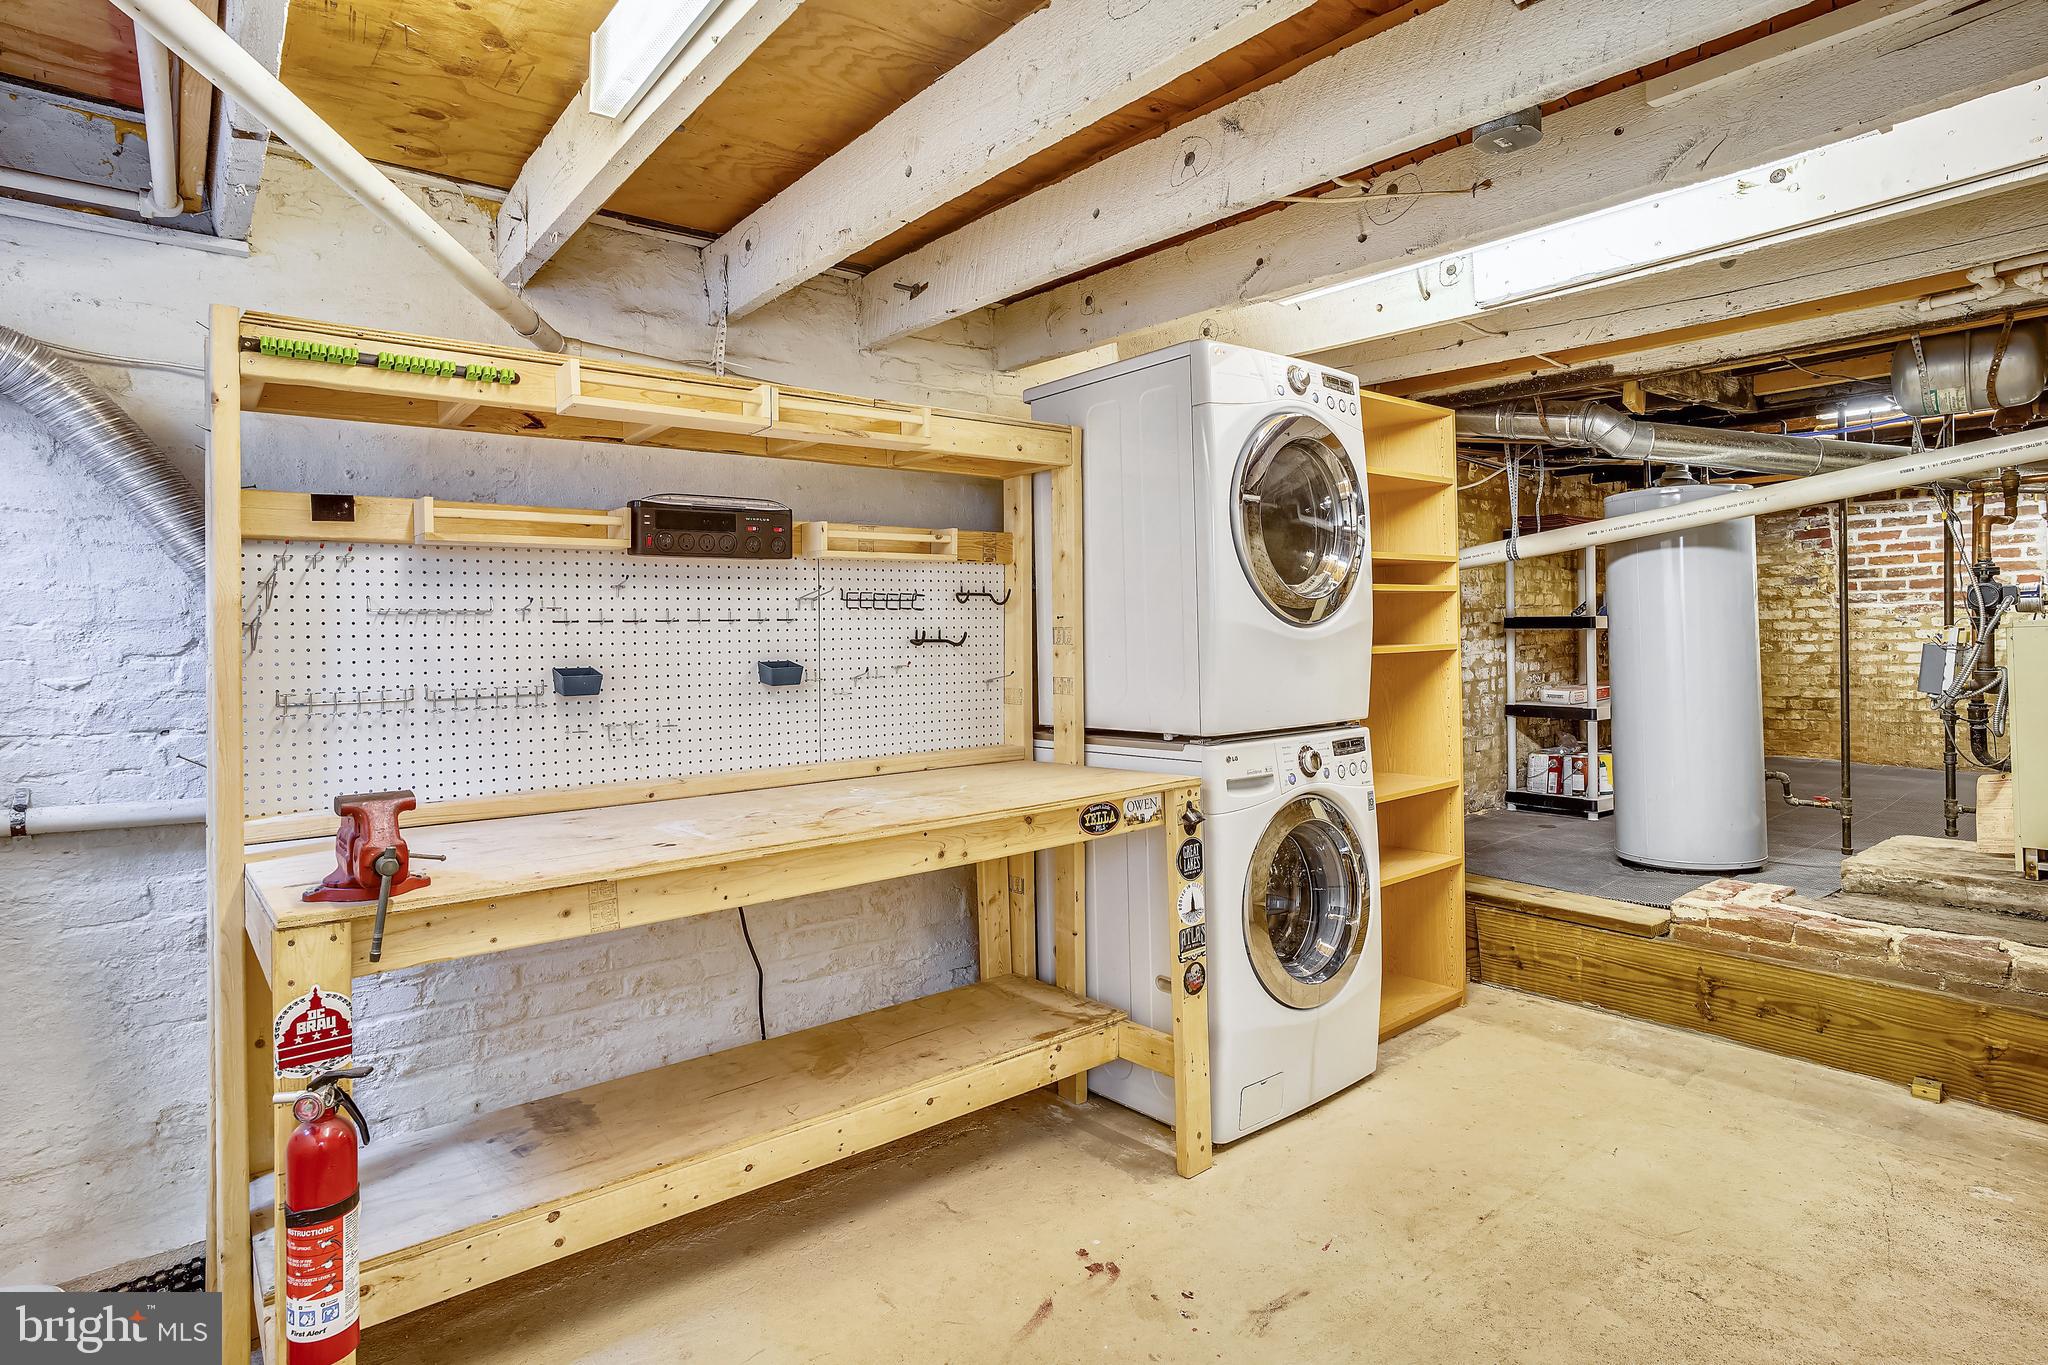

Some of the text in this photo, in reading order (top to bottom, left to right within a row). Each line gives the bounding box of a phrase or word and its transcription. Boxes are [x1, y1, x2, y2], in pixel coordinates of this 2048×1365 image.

[1126, 797, 1158, 812] OWEN
[1083, 810, 1117, 826] YELLA
[1182, 843, 1200, 858] GREAT
[1183, 856, 1201, 872] LAKES
[1180, 924, 1205, 953] ATLAS
[307, 1008, 326, 1021] DC
[290, 1327, 328, 1337] First Alert
